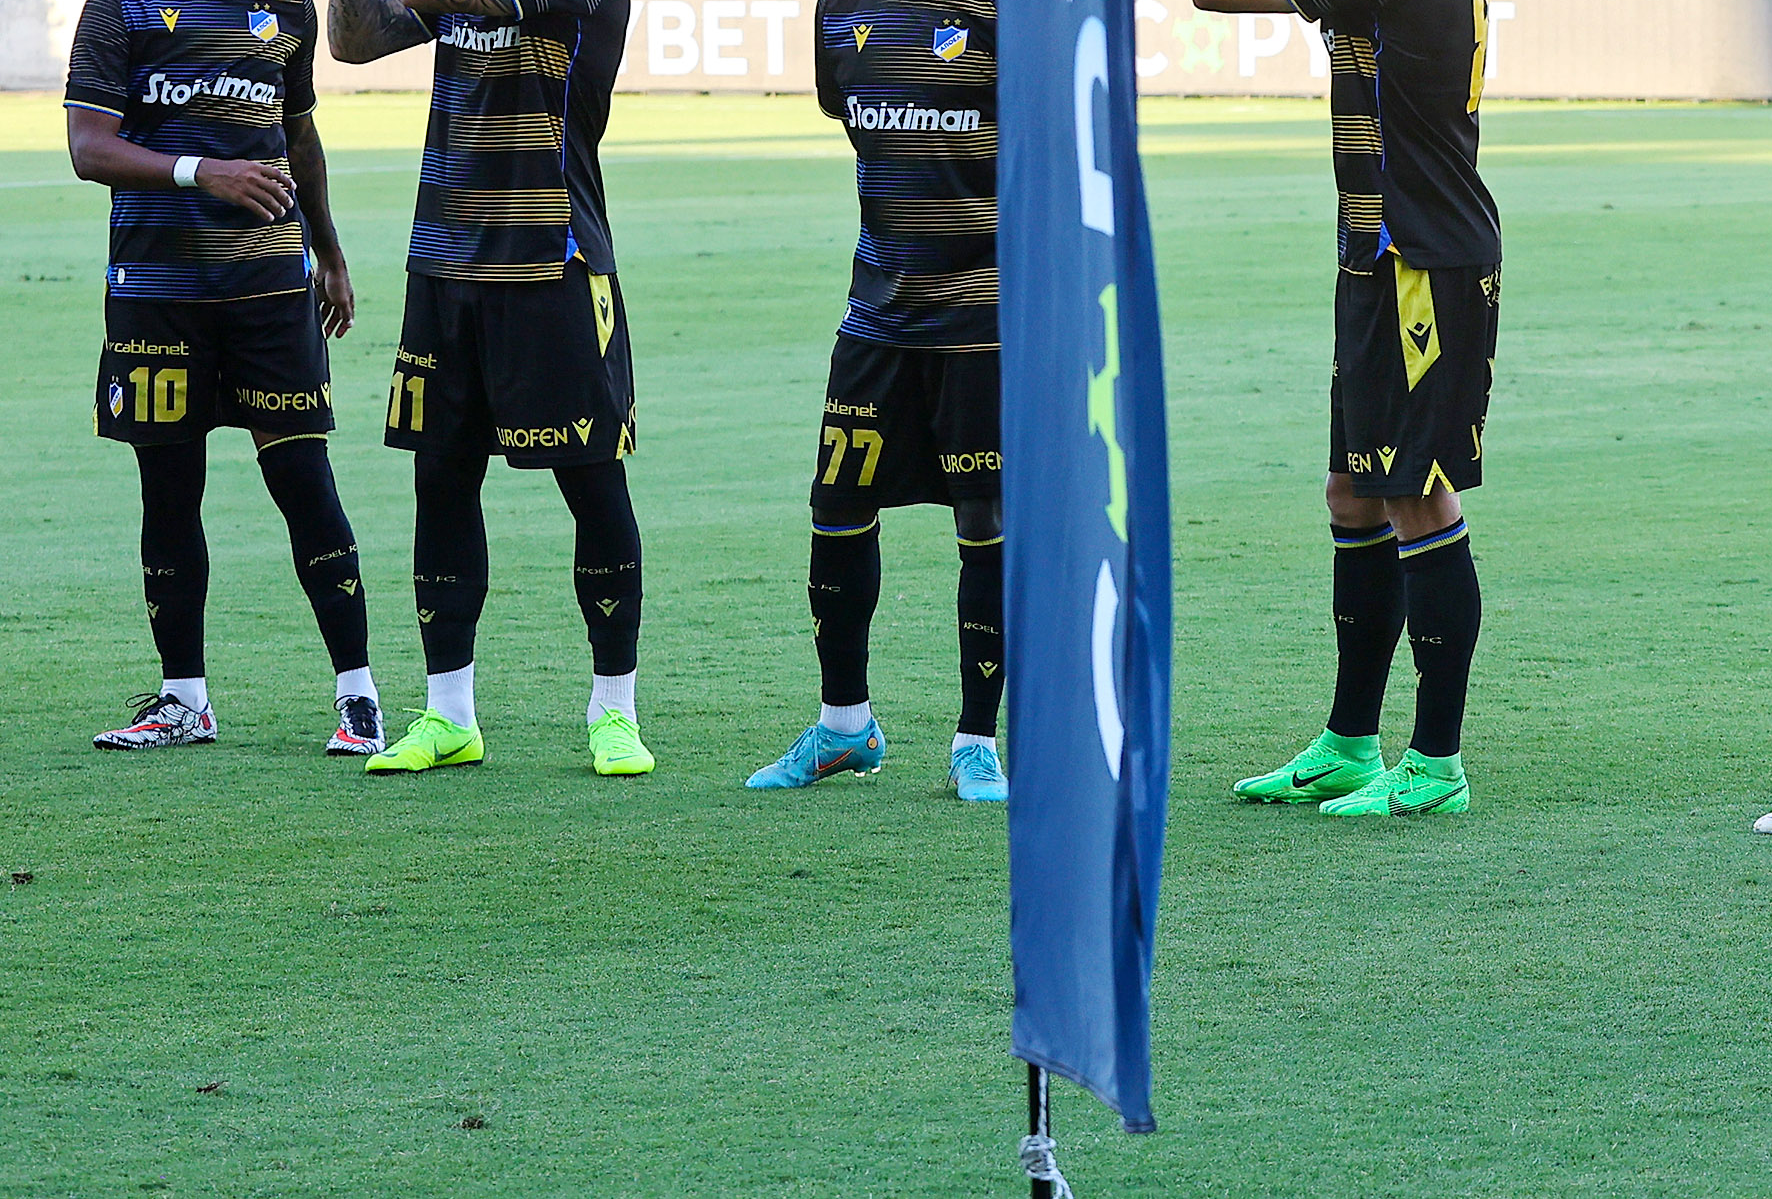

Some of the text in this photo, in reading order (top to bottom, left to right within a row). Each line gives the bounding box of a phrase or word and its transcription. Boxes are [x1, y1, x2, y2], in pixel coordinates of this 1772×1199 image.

[141, 71, 277, 106] Stoiximan
[846, 95, 981, 132] Stoiximan
[114, 338, 190, 356] cablenet
[128, 366, 188, 423] 10
[388, 371, 425, 433] 11
[821, 425, 884, 487] 77
